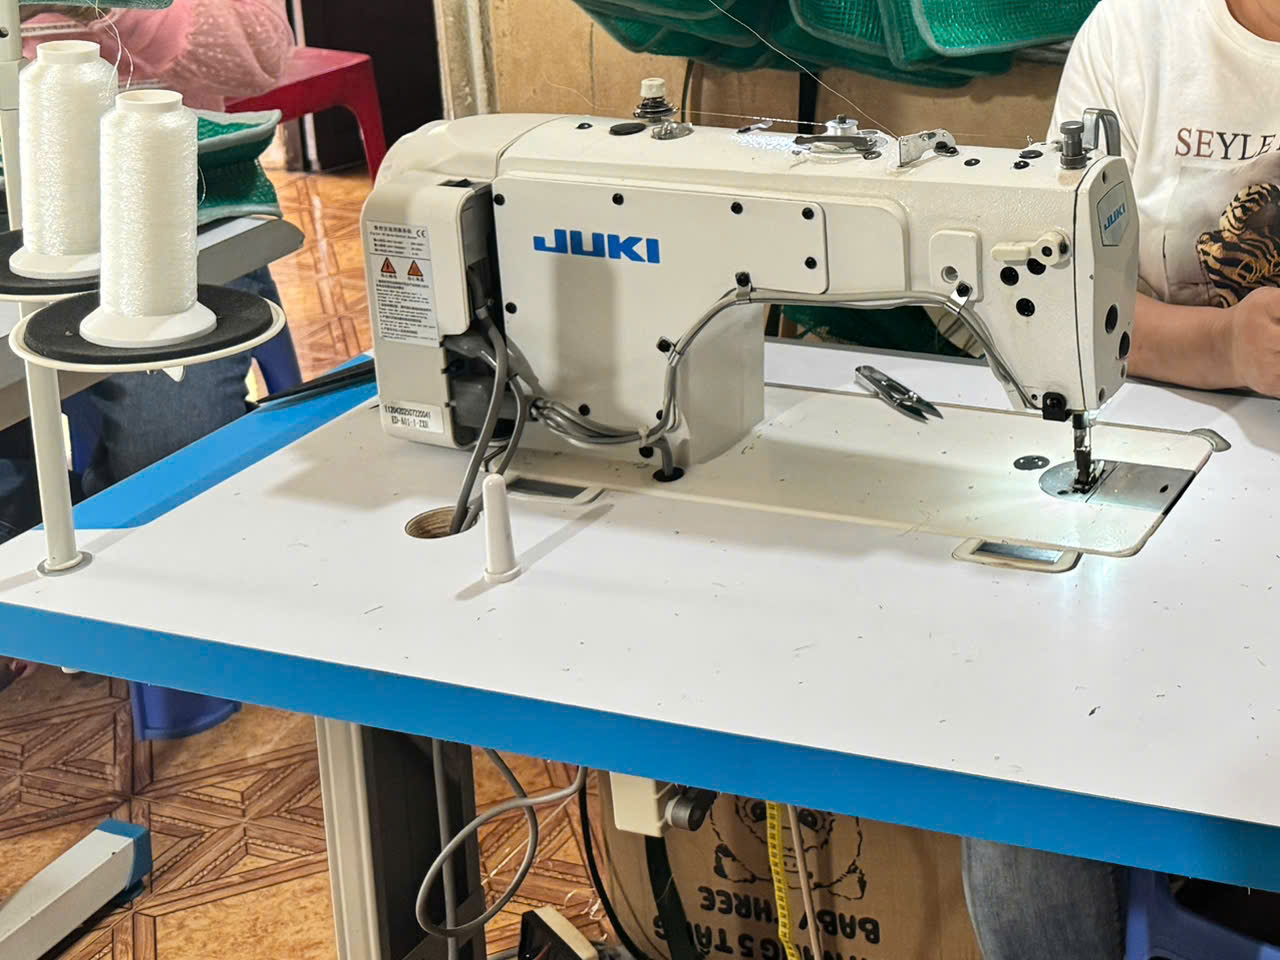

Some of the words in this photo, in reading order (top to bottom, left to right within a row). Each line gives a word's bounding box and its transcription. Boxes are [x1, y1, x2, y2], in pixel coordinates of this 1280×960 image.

[1104, 202, 1126, 231] JUKI
[533, 228, 660, 264] JUKI
[698, 885, 779, 923] HREE
[738, 933, 754, 958] 5
